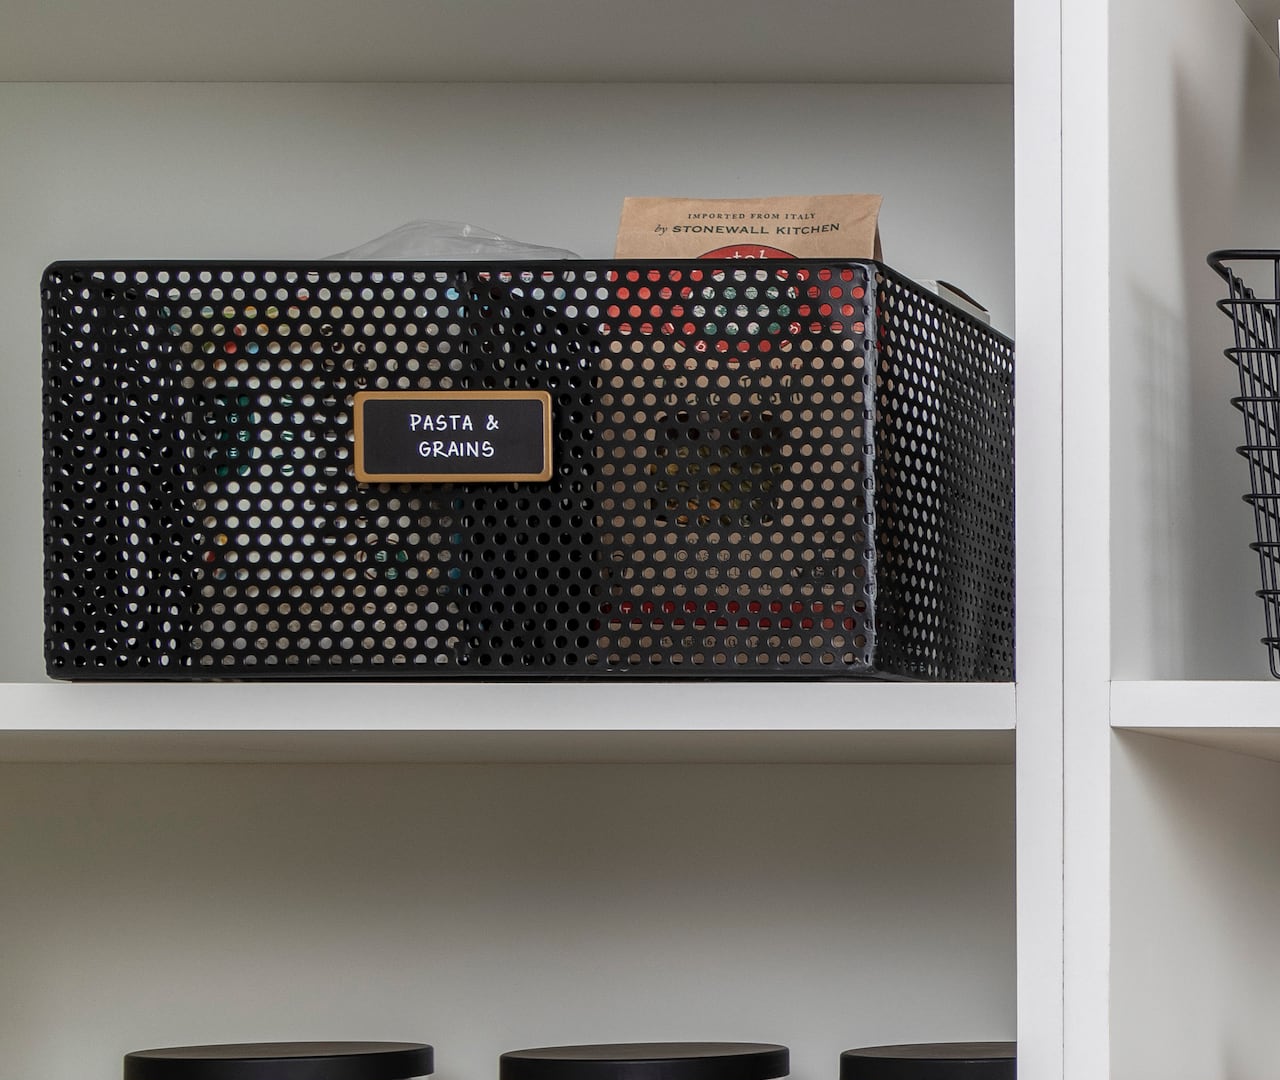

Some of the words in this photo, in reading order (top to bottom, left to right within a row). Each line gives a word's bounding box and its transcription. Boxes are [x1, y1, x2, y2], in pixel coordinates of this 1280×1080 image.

[687, 212, 745, 220] IMPORTED
[750, 212, 780, 220] FROM
[785, 212, 816, 220] ITALY
[654, 223, 668, 236] by
[672, 225, 769, 234] STONEWALL
[776, 223, 841, 235] KITCHEN
[409, 414, 473, 431] PASTA
[486, 414, 500, 431] &
[418, 440, 495, 458] GRAINS
